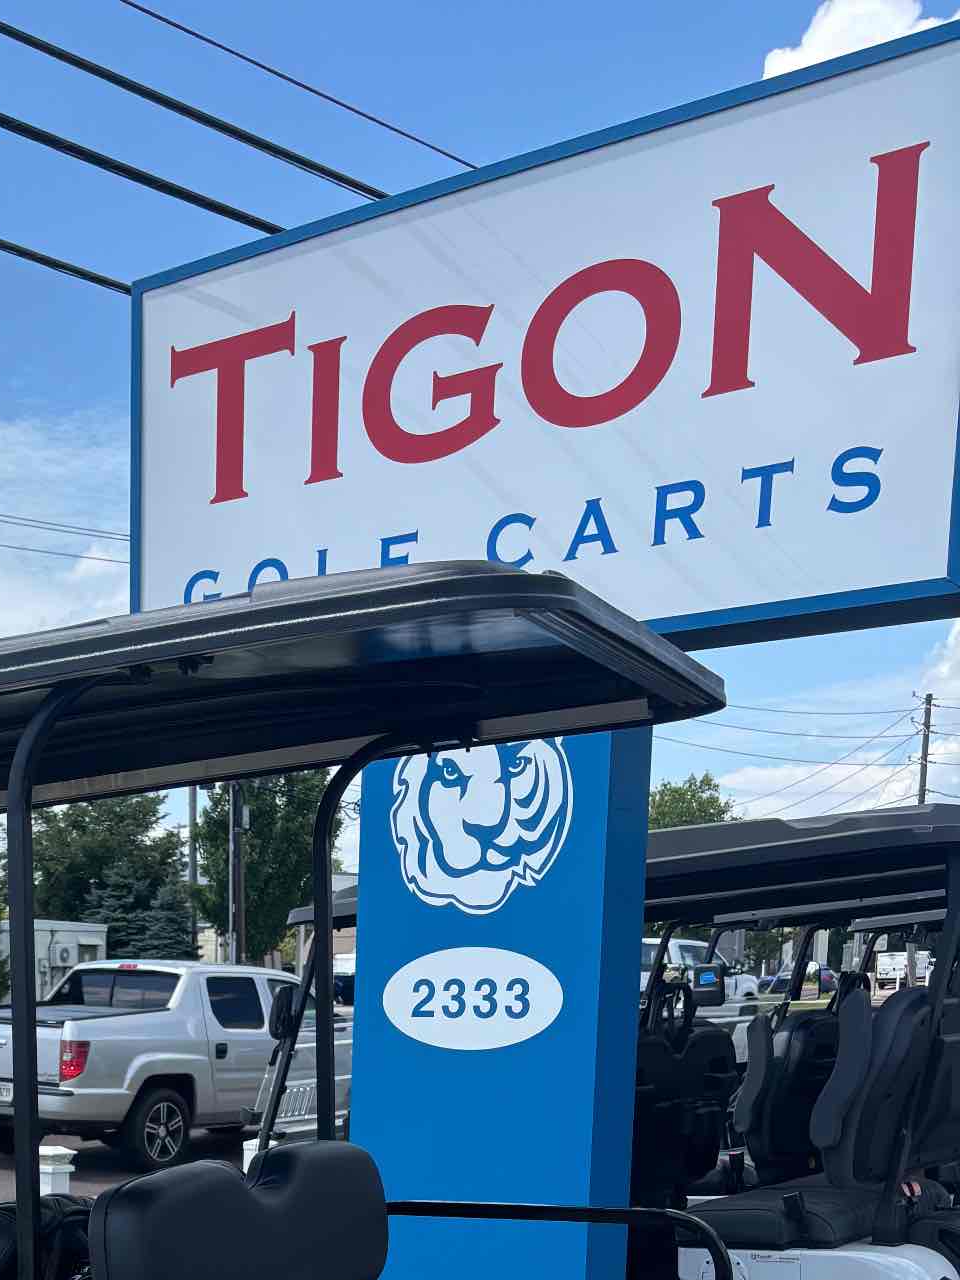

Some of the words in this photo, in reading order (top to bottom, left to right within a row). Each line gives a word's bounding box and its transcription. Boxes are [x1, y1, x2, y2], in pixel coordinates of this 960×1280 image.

[170, 141, 930, 505] TIGON
[485, 445, 884, 573] CARTS
[411, 978, 530, 1019] 2333
